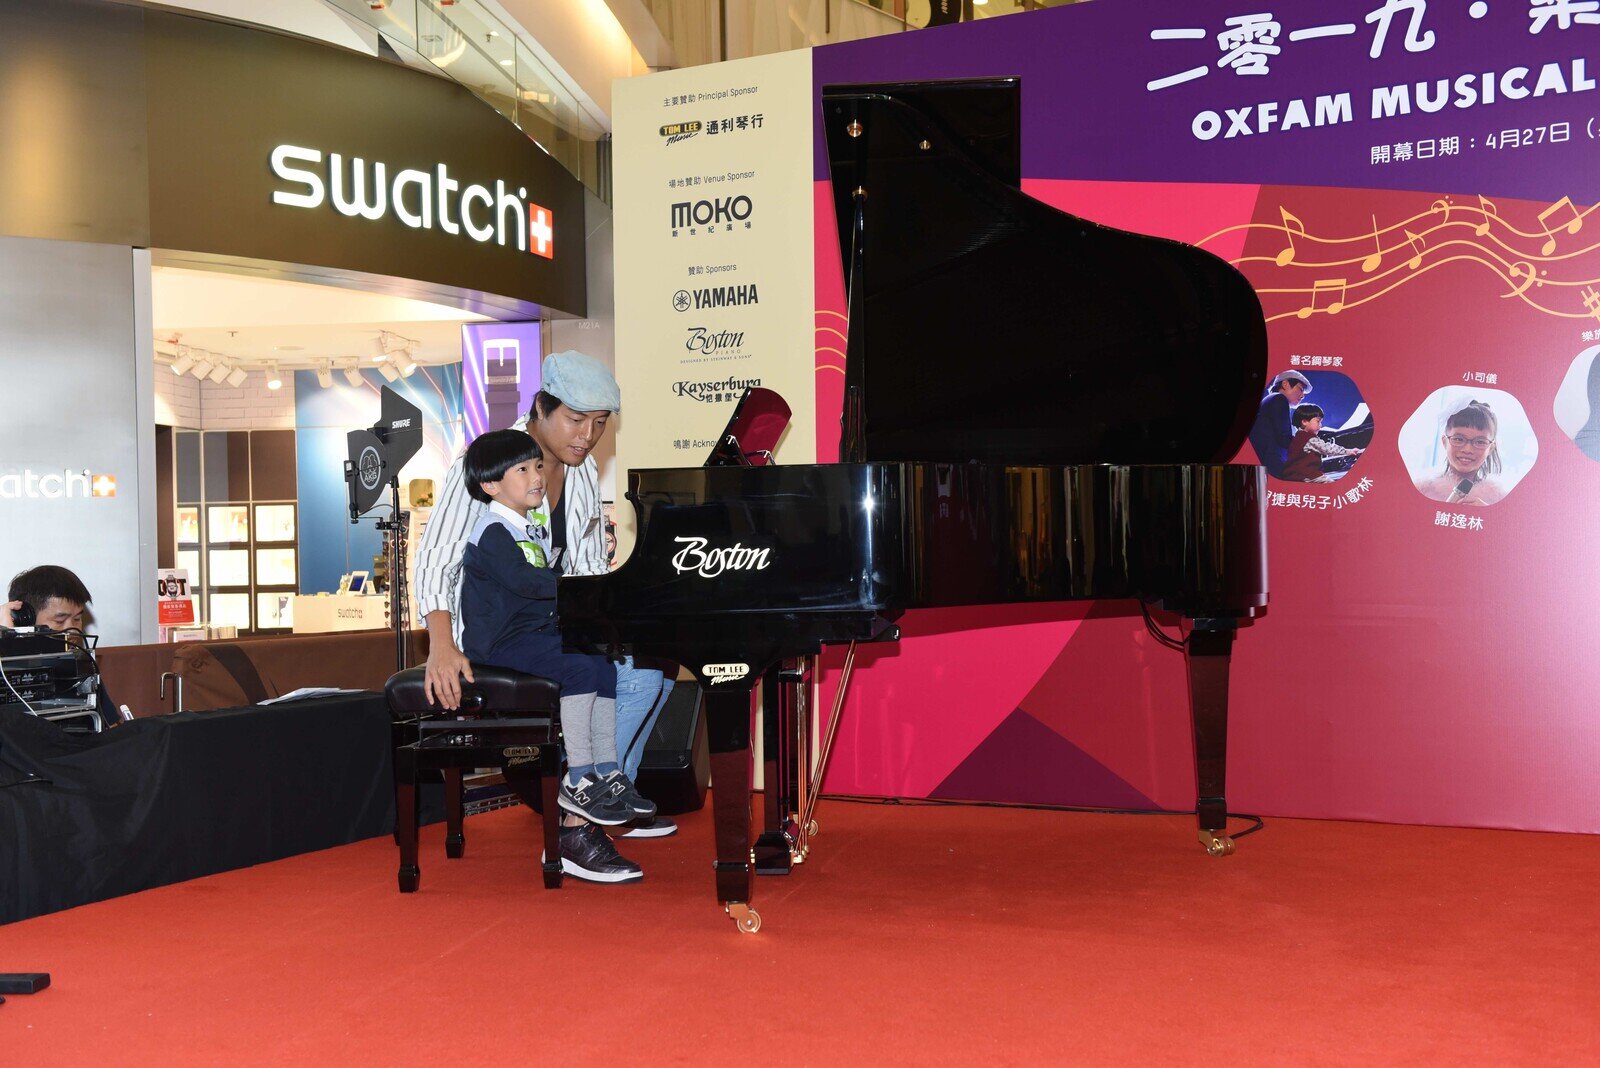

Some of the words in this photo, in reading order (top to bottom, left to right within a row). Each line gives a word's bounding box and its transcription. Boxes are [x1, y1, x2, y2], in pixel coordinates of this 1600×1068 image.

[698, 89, 729, 102] Principal
[730, 86, 758, 98] Sponsor
[1191, 92, 1354, 141] OXFAM
[1371, 58, 1597, 120] MUSICAL
[664, 124, 680, 135] TOM
[684, 122, 699, 132] LEE
[706, 113, 764, 135] 通利琴行
[704, 174, 725, 184] Venue
[727, 171, 755, 181] Sponsor
[270, 144, 527, 252] swatch
[671, 195, 753, 229] MOKO
[706, 264, 737, 274] Sponsors
[693, 284, 759, 309] YAMAHA
[686, 327, 744, 355] Boston
[1290, 354, 1343, 367] 著名鋼琴家
[1462, 371, 1498, 385] 小司儀
[392, 419, 411, 429] SHURE
[693, 439, 717, 448] Ackno
[1434, 511, 1485, 532] 謝逸林
[671, 536, 771, 578] Boston
[708, 666, 726, 674] TOM
[730, 665, 744, 673] LEE
